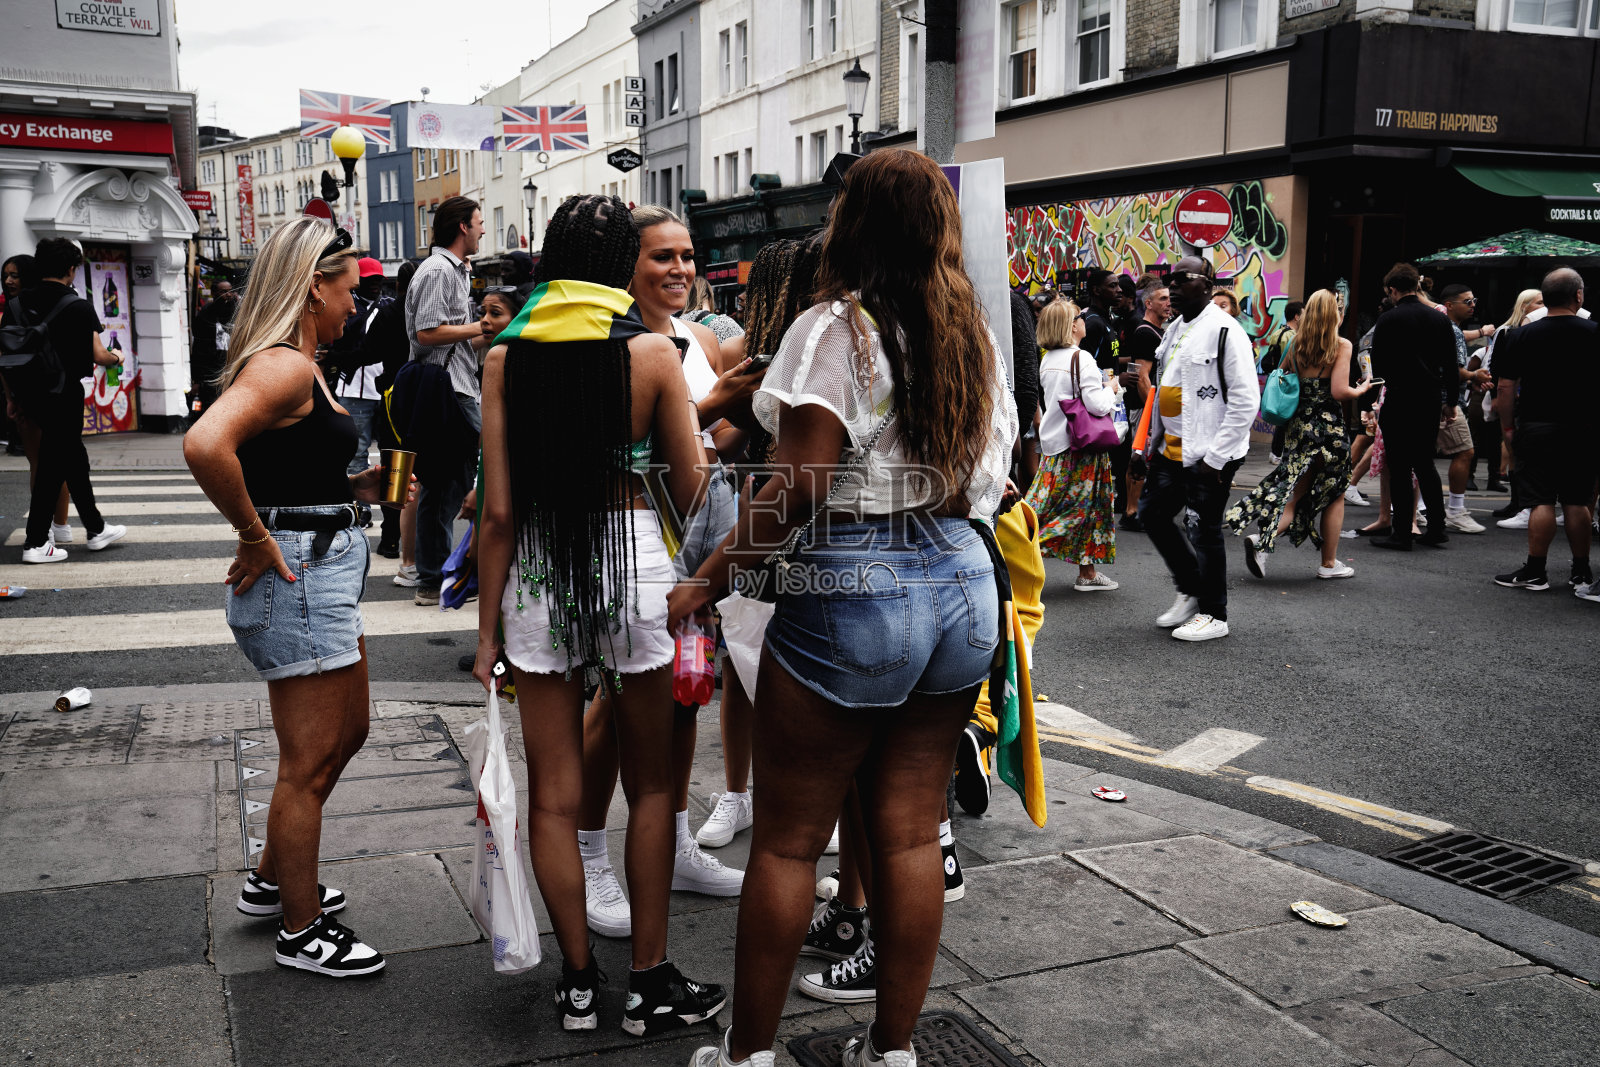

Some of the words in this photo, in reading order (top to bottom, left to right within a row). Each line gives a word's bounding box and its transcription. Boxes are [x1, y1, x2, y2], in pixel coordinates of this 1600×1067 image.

[80, 2, 136, 18] COLVILLE
[1291, 3, 1313, 16] ROAD
[630, 79, 640, 124] BAR
[1375, 108, 1392, 127] 177
[1396, 109, 1437, 130] TRAILER
[1439, 112, 1498, 133] HAPPINESS
[26, 123, 113, 143] Exchange
[1550, 208, 1586, 220] COCKTAILS
[1586, 209, 1592, 220] &
